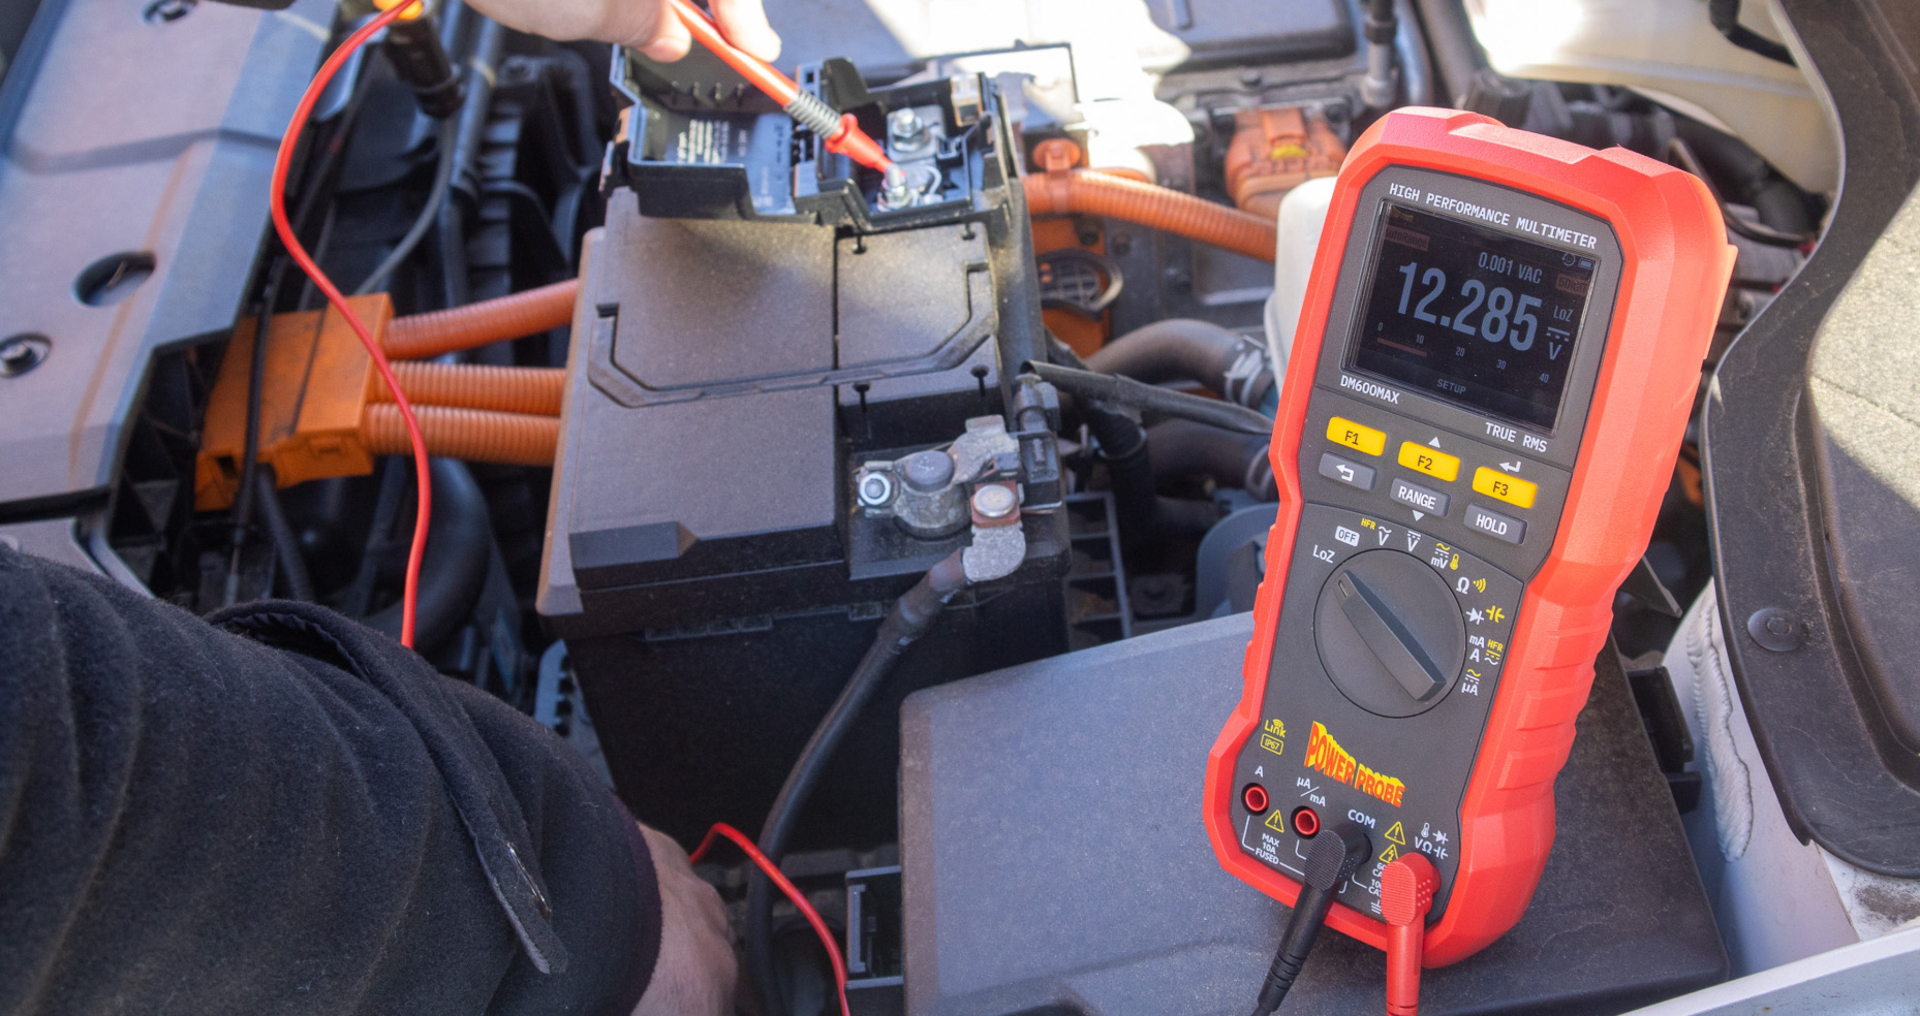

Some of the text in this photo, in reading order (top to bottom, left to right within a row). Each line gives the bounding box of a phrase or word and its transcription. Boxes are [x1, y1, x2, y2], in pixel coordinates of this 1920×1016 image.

[1389, 182, 1420, 201] HIGH
[1426, 193, 1510, 226] PERFORMANCE
[1516, 217, 1597, 249] MULTIMETER
[1477, 252, 1542, 284] 0.001 VAC
[1398, 261, 1543, 351] 12.285
[1416, 334, 1425, 345] 10
[1455, 347, 1465, 357] 20
[1496, 359, 1507, 370] 30
[1539, 373, 1550, 383] 40
[1549, 342, 1562, 360] V
[1340, 375, 1400, 404] DM600MAX
[1436, 378, 1466, 395] SETUP
[1345, 430, 1359, 446] F1
[1486, 422, 1548, 453] TRUE RMS
[1417, 455, 1432, 470] F2
[1493, 481, 1509, 496] F3
[1398, 486, 1436, 510] RANGE
[1361, 517, 1376, 530] HFR
[1476, 514, 1507, 535] HOLD
[1338, 529, 1357, 543] OFF
[1312, 545, 1336, 563] LoZ
[1430, 556, 1448, 569] mV
[1469, 635, 1485, 648] mA
[1487, 639, 1503, 652] HFR
[1469, 648, 1480, 662] A
[1264, 719, 1286, 738] Link
[1264, 738, 1280, 750] IP67
[1255, 765, 1264, 778] A
[1304, 720, 1406, 808] POWER PROBE
[1347, 809, 1376, 829] COM
[1261, 833, 1280, 848] MAX
[1262, 842, 1276, 855] 10A
[1255, 848, 1279, 865] FUSED
